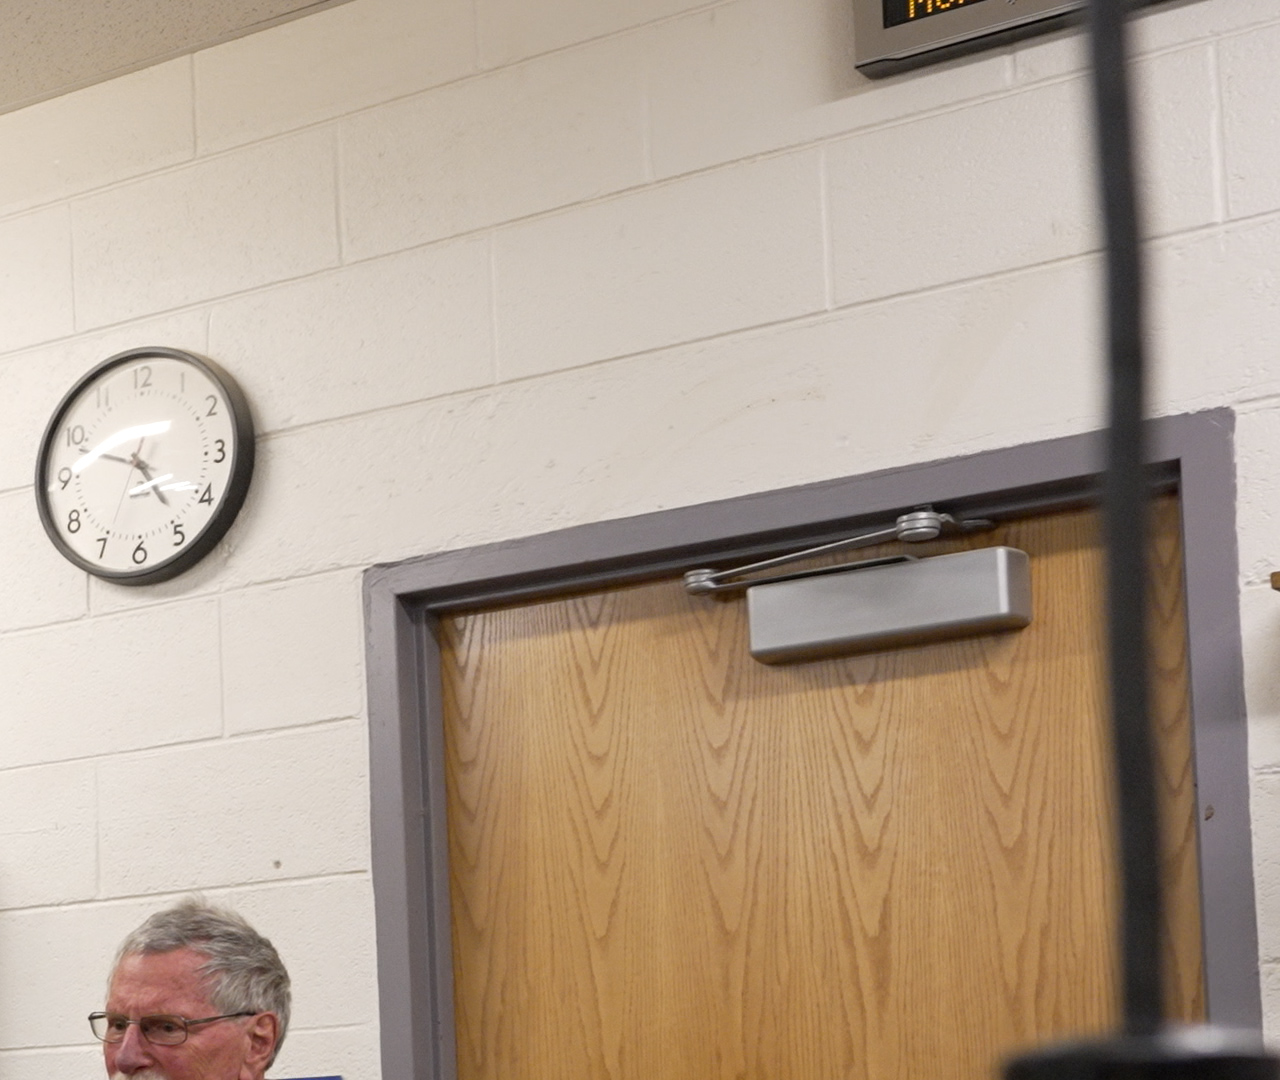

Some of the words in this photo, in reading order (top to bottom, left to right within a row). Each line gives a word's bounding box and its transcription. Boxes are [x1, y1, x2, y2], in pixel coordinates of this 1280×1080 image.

[133, 366, 153, 389] 12
[96, 386, 110, 408] 11
[205, 394, 218, 417] 2
[66, 425, 85, 447] 10
[214, 439, 226, 463] 3
[58, 467, 73, 491] 9
[198, 483, 214, 506] 4
[67, 510, 81, 533] 8
[173, 524, 186, 547] 5
[96, 538, 107, 559] 7
[132, 541, 148, 564] 6
